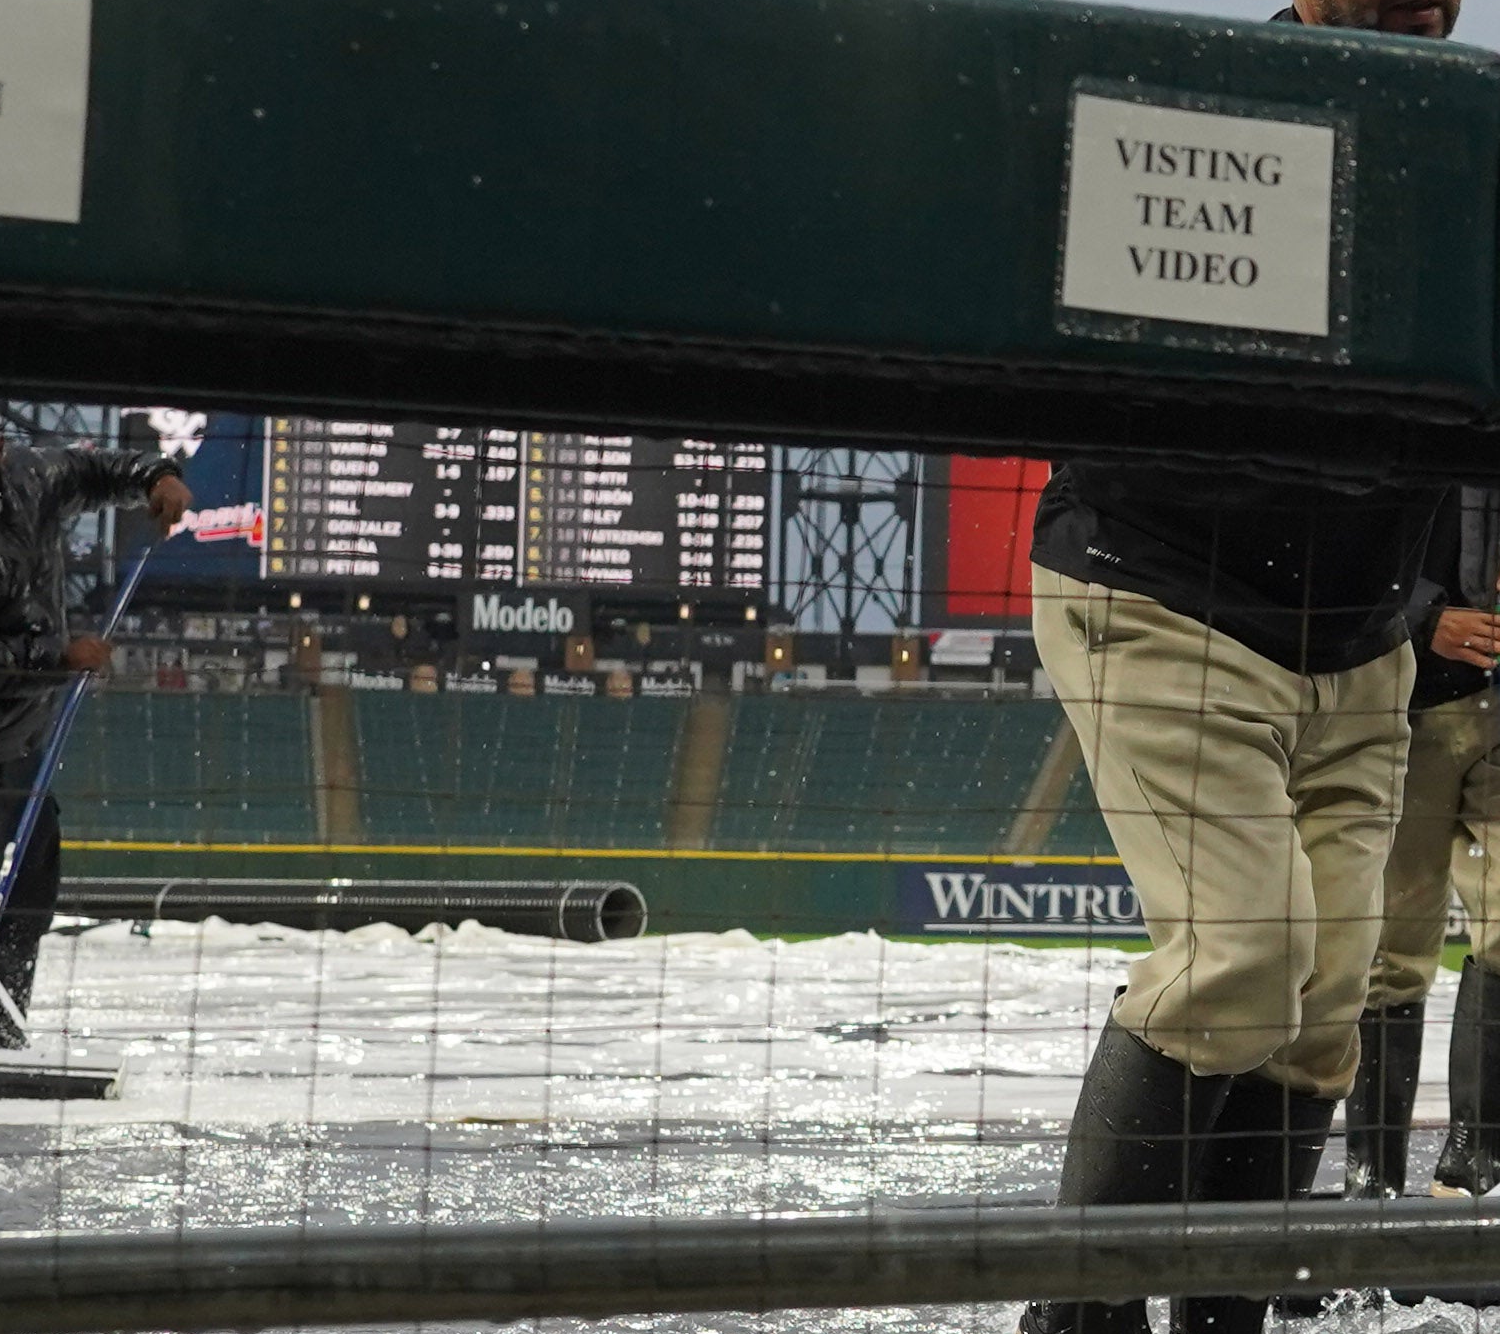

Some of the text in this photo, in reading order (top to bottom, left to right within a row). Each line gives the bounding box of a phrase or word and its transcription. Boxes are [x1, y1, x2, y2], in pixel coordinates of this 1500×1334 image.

[1115, 137, 1282, 186] VISTING
[1135, 192, 1255, 235] TEAM
[1127, 245, 1259, 288] VIDEO
[581, 449, 632, 466] OLSON
[326, 479, 414, 497] MONTGOMERY
[325, 499, 360, 516] HILL
[580, 508, 622, 525] RILEY
[325, 519, 402, 540] GONZALEZ
[578, 548, 631, 565] MATEO
[1085, 546, 1122, 564] DRI-FIT
[324, 559, 380, 576] PETERS
[472, 593, 574, 633] Modelo
[923, 872, 1141, 924] WINTRU
